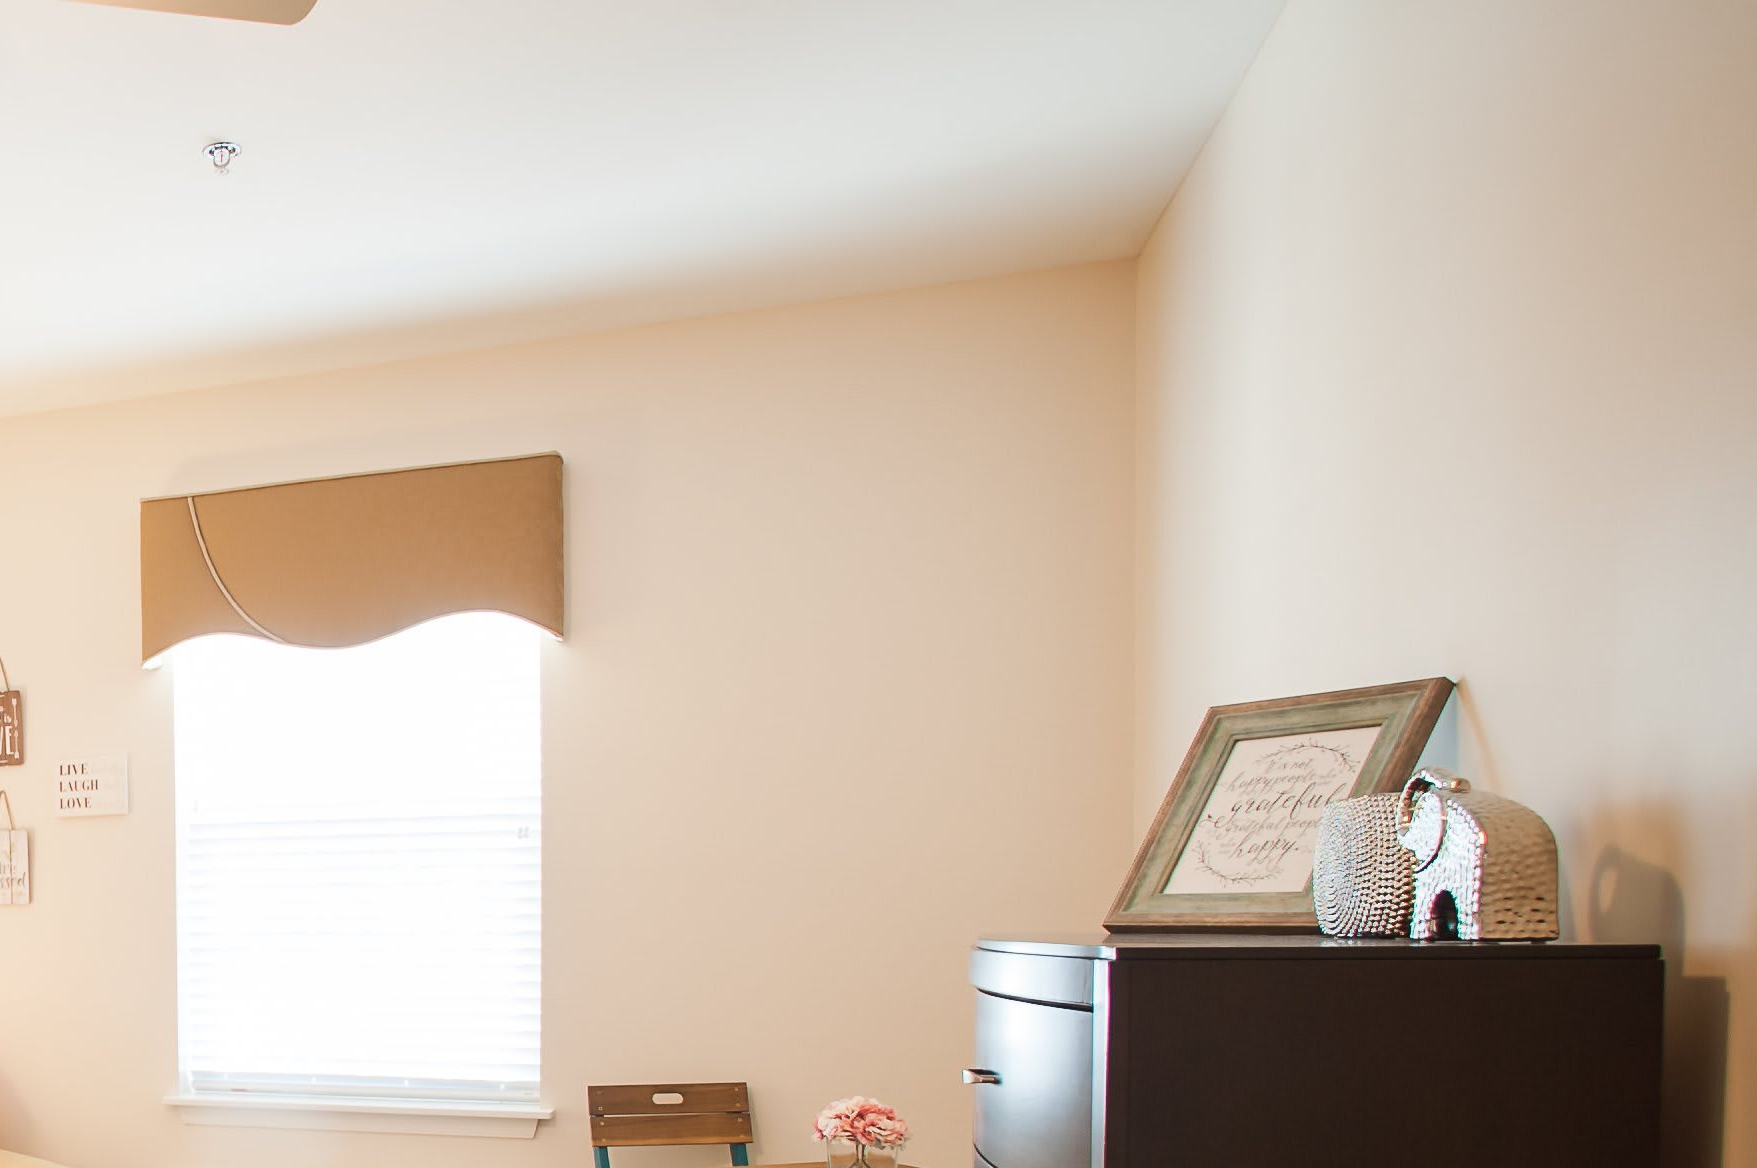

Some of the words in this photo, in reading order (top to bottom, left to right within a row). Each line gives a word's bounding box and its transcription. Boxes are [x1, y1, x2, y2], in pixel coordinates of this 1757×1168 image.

[4, 713, 12, 723] is
[60, 763, 89, 776] LIVE
[59, 779, 98, 792] LAUGH
[60, 797, 92, 809] LOVE
[1216, 782, 1346, 826] grateful
